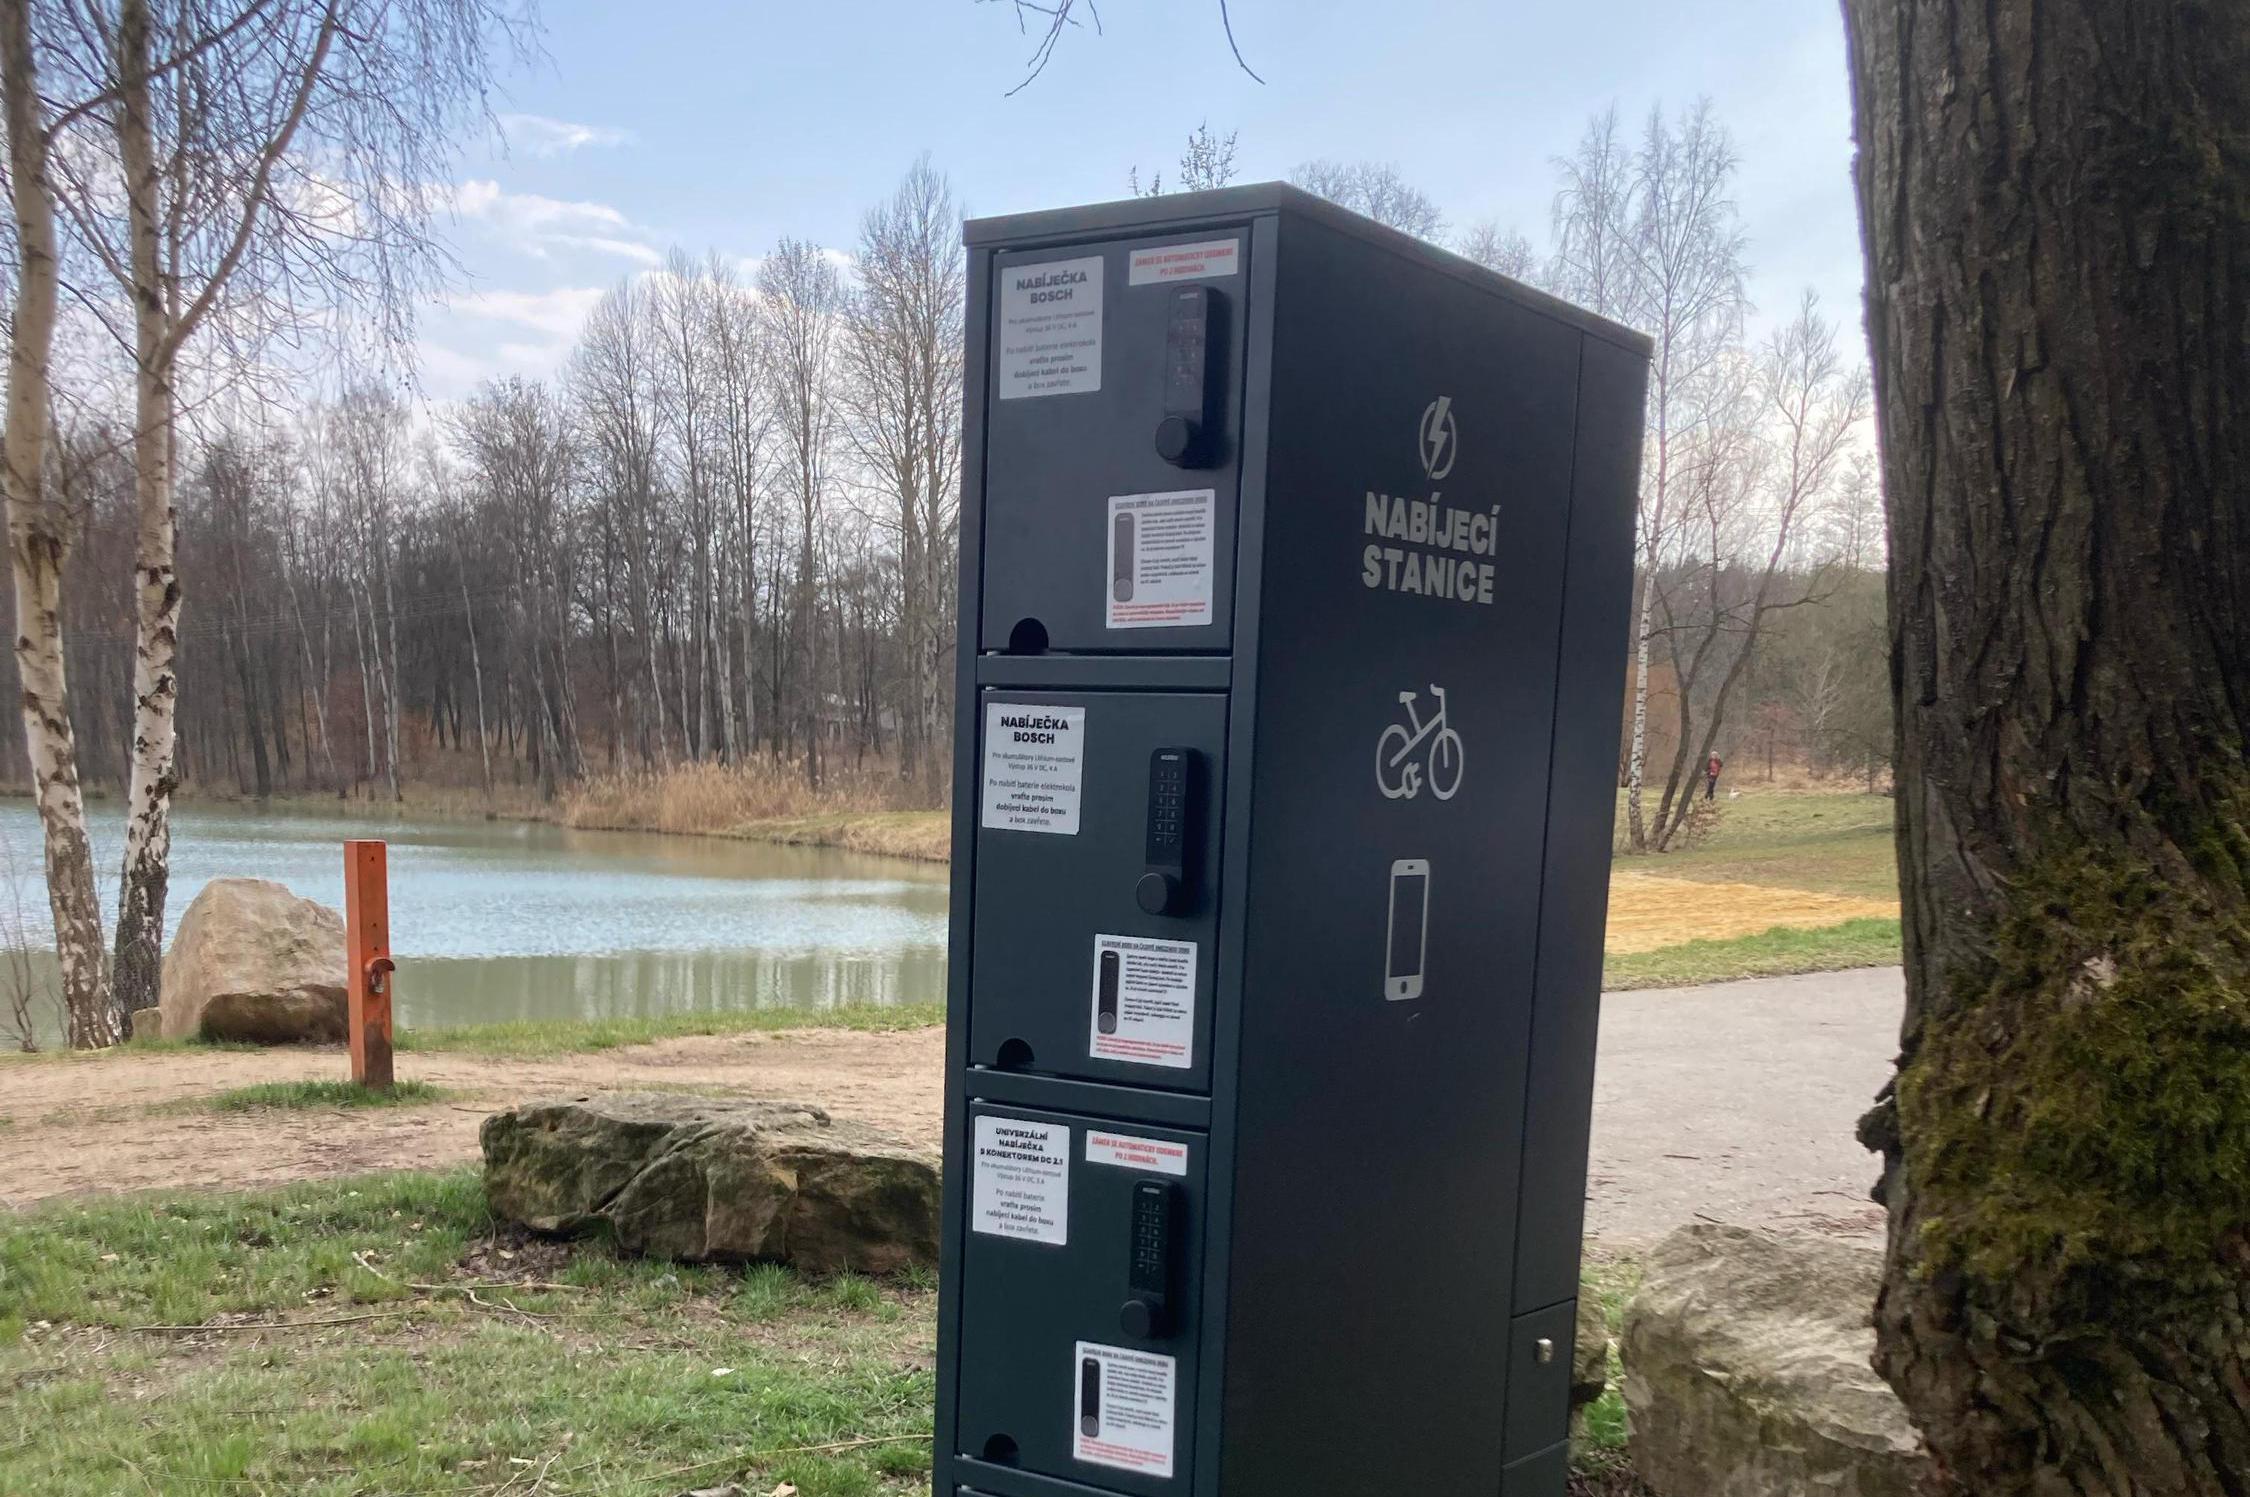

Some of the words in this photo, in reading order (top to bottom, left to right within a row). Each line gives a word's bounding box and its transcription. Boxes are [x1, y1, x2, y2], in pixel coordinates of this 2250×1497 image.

[1016, 270, 1088, 291] NABÍJEČKA
[1030, 288, 1073, 304] BOSCH
[1364, 491, 1501, 556] NABÍJECÍ
[1362, 544, 1495, 604] STANICE
[1001, 714, 1069, 730] NABÍJEČKA
[1013, 731, 1055, 744] BOSCH
[1040, 806, 1049, 814] do
[995, 1128, 1048, 1140] UNIVERZÁLNÍ
[999, 1139, 1044, 1151] NABÍJEČKA
[986, 1149, 1039, 1162] KONEKTOREM
